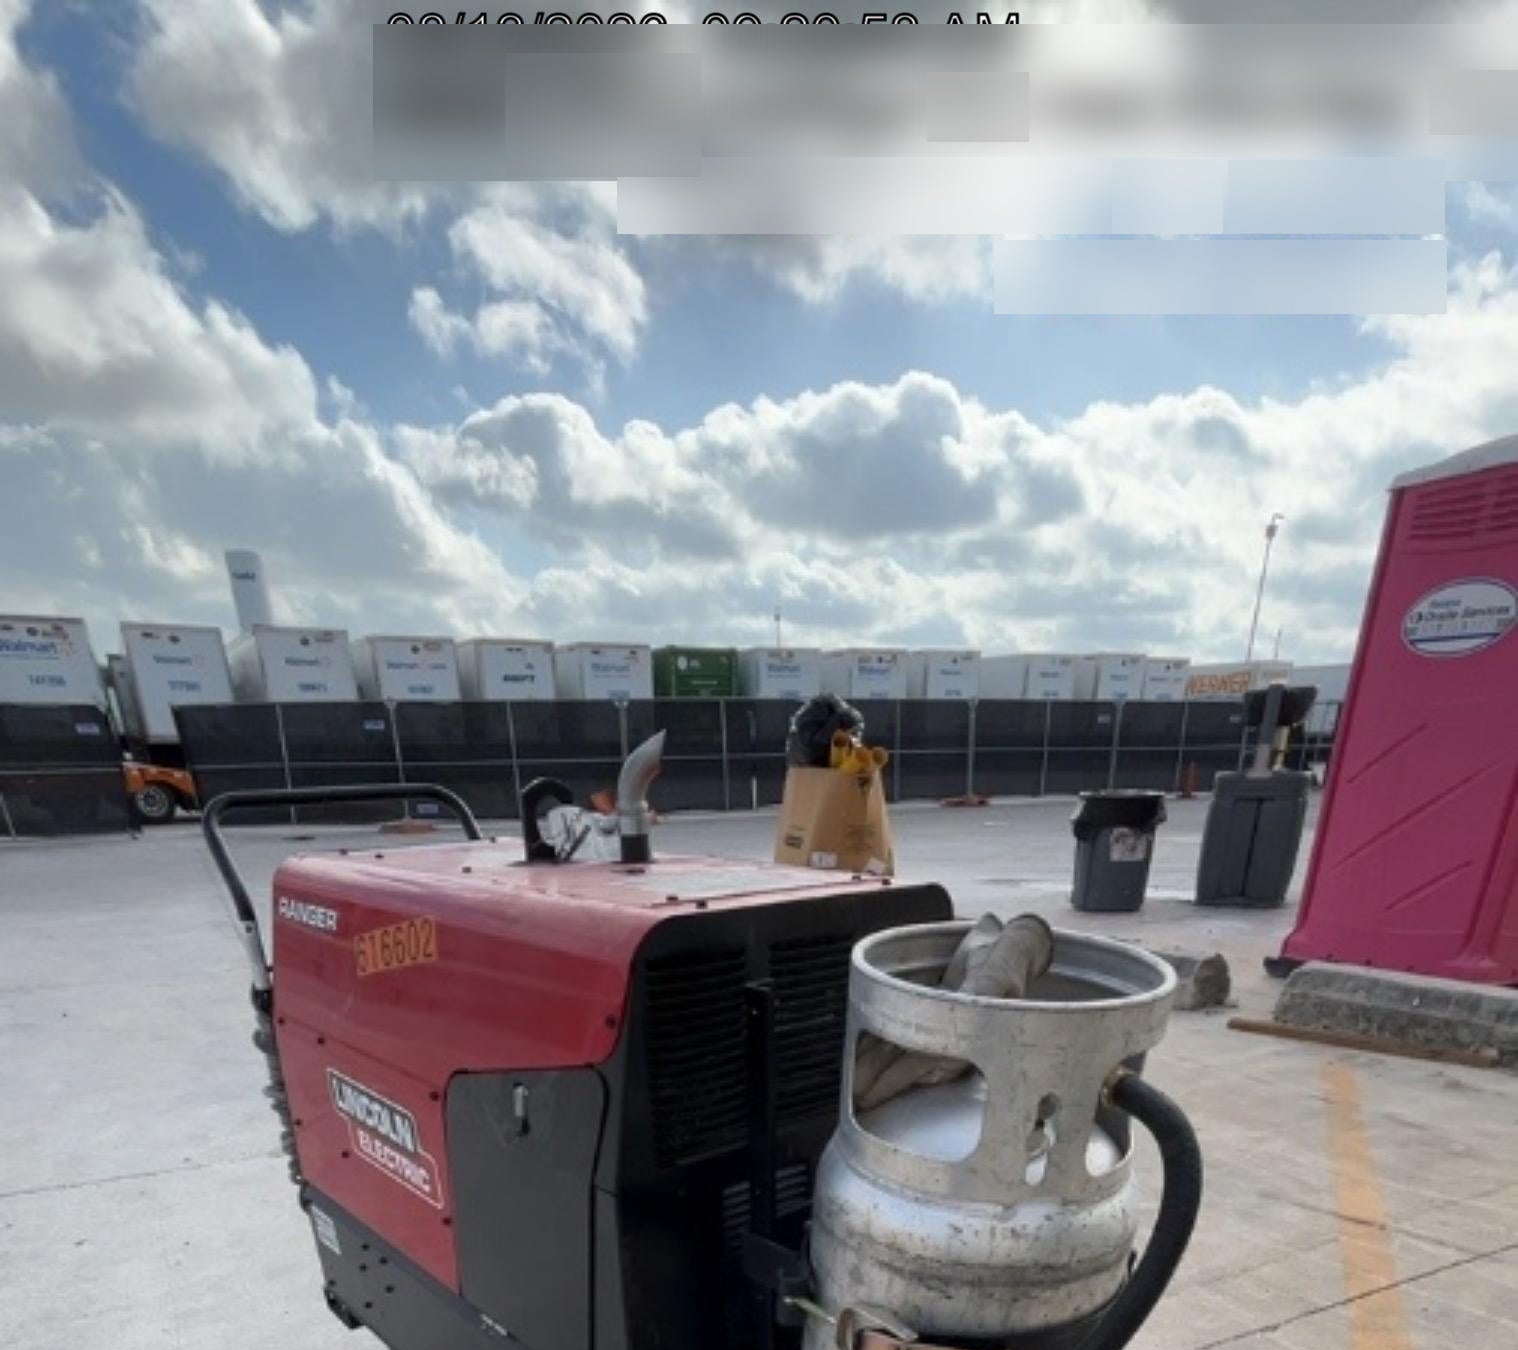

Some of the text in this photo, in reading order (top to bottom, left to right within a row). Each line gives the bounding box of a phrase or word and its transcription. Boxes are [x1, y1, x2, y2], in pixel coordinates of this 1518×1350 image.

[279, 896, 337, 931] RANGER
[332, 1078, 415, 1153] LINCOLN
[357, 1129, 430, 1192] ELECTRIC
